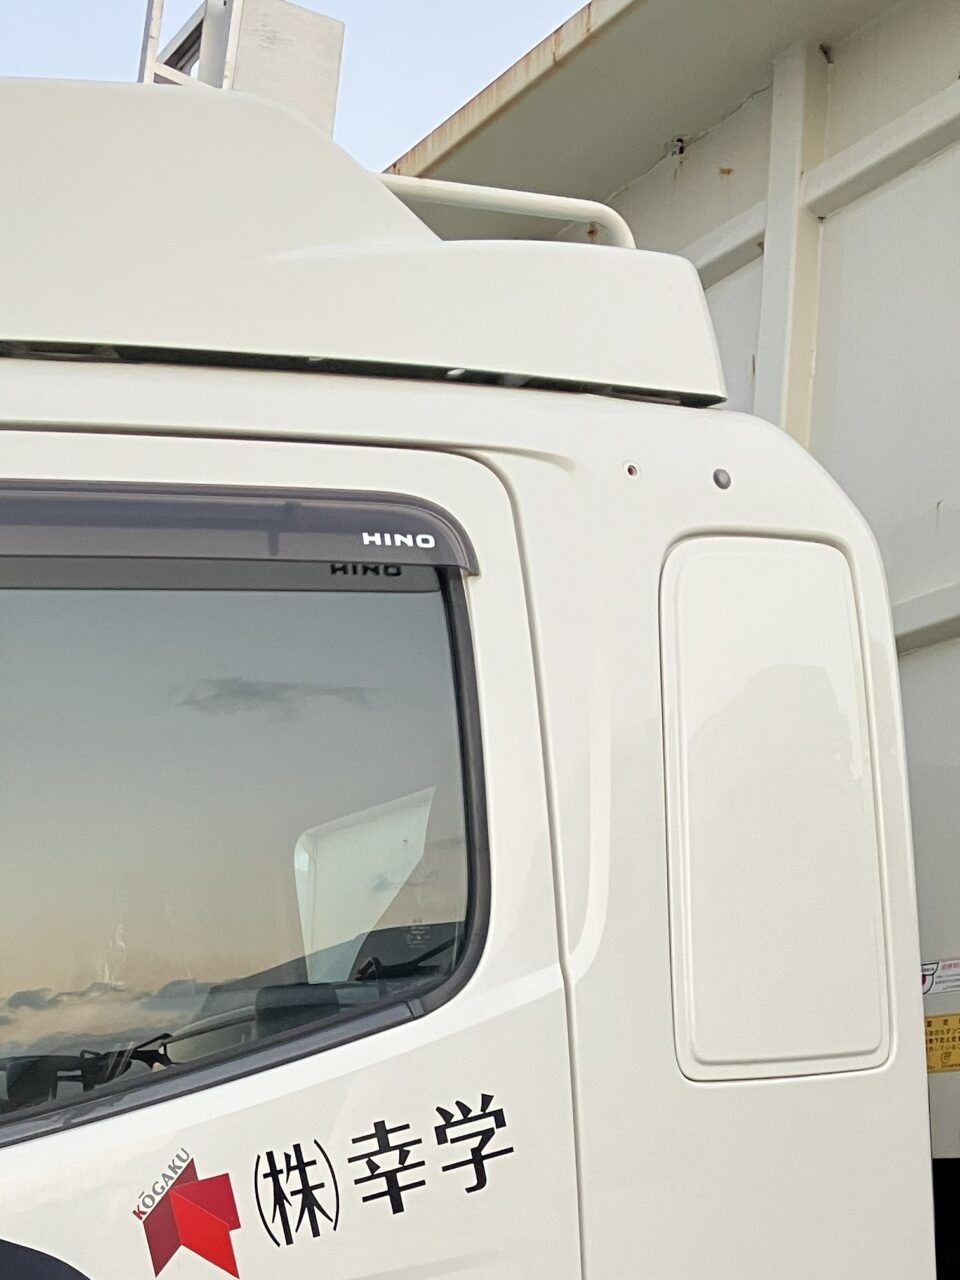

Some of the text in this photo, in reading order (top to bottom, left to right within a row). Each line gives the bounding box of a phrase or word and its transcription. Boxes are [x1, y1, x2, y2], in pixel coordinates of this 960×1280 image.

[362, 532, 435, 548] HINO
[330, 563, 402, 577] HINO
[253, 1093, 514, 1248] (株)幸学
